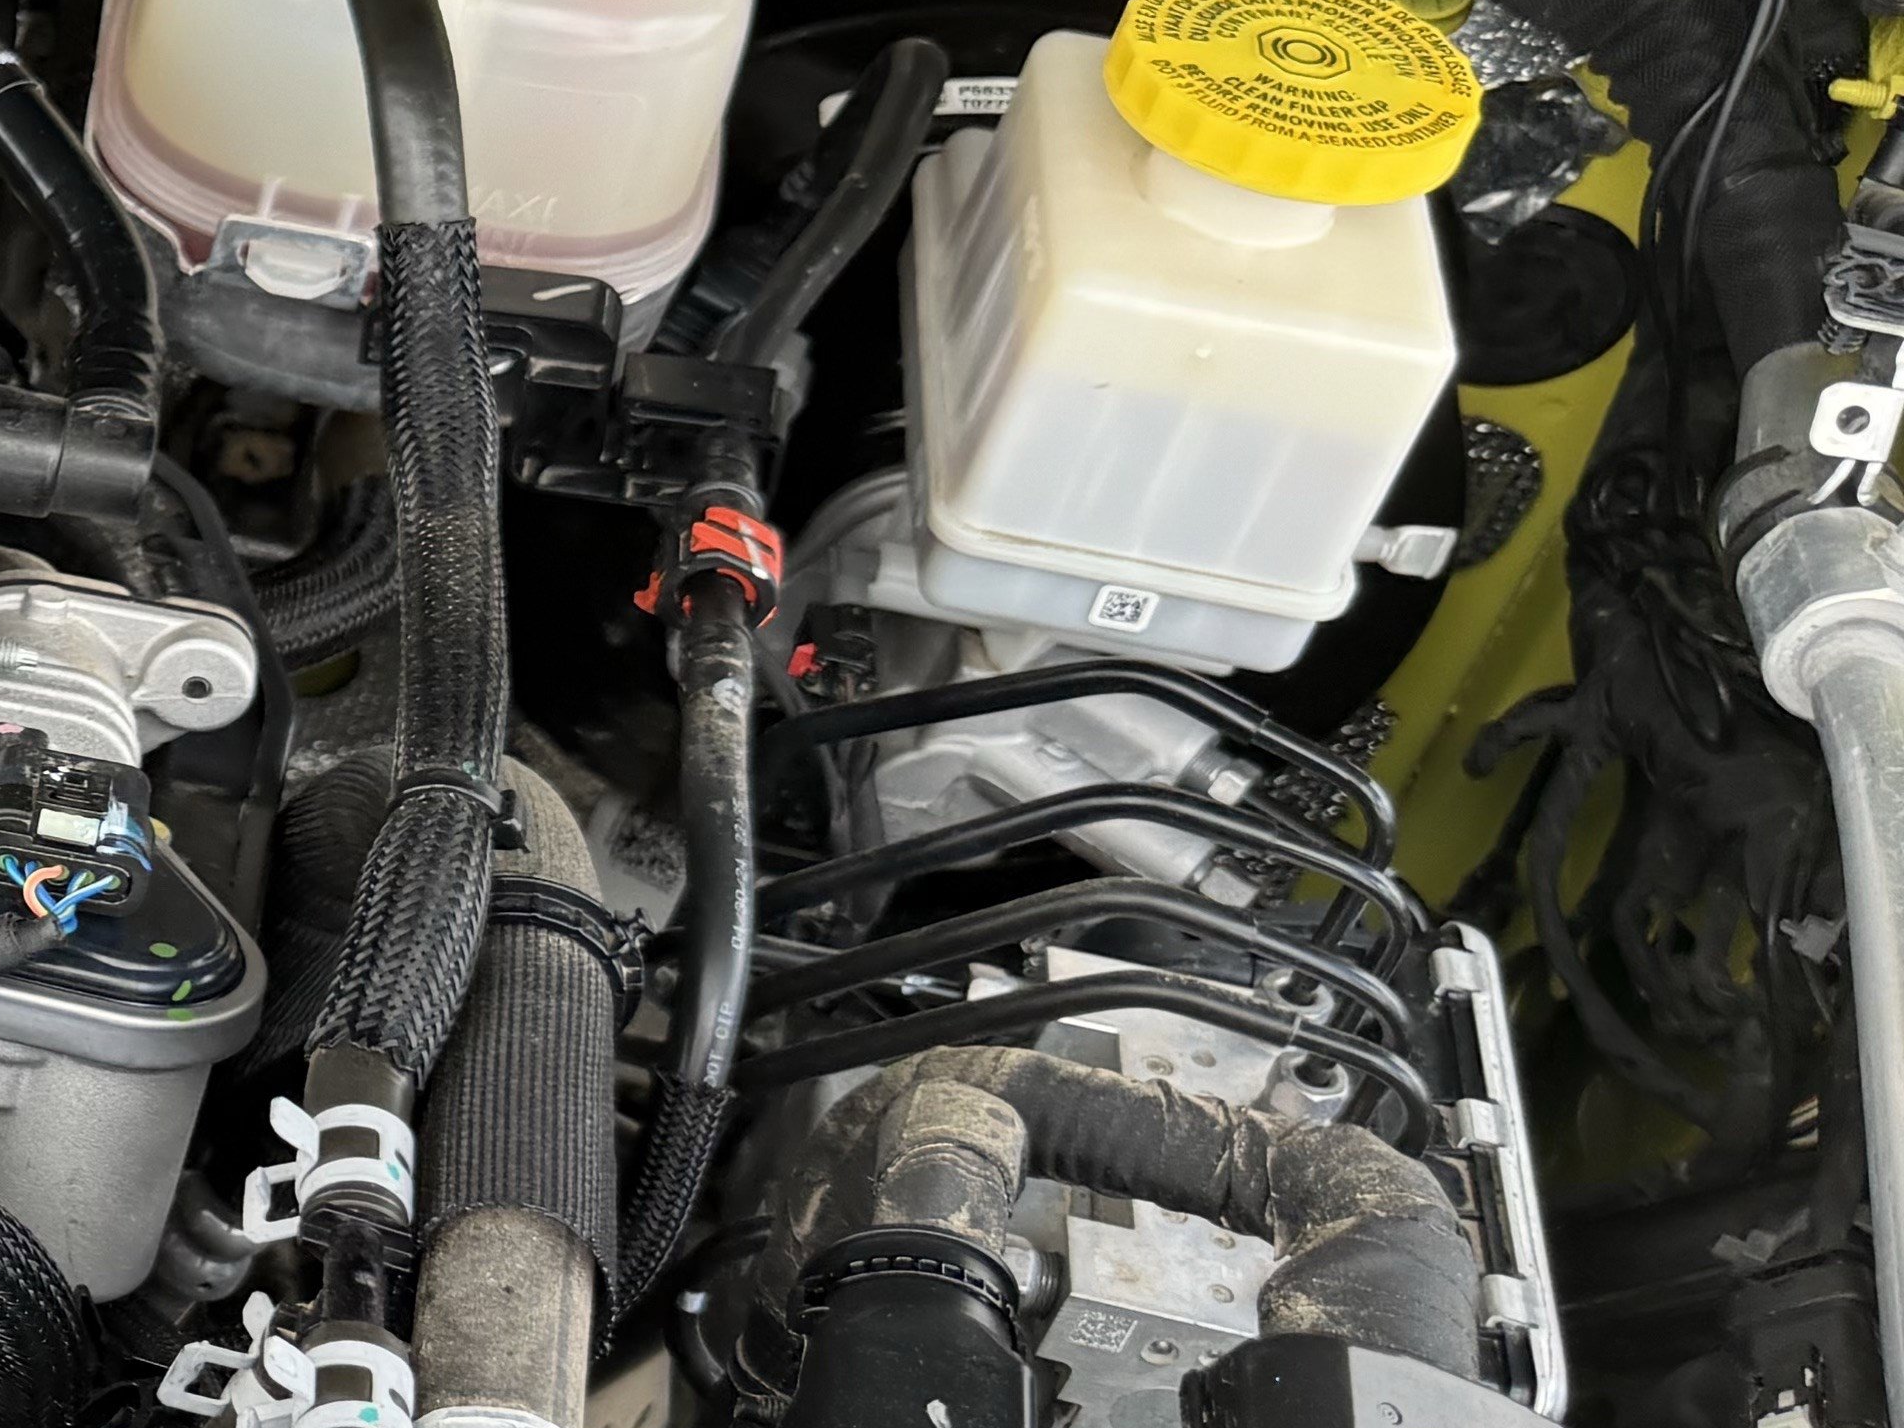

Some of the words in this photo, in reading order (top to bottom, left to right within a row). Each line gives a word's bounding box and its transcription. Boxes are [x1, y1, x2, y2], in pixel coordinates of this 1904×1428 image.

[1372, 14, 1443, 85] UNIQUEMENT
[1389, 9, 1419, 26] DE
[1410, 23, 1471, 98] REMPLISSAGE
[1148, 59, 1188, 81] DOT
[1187, 88, 1239, 116] FLUID
[1238, 113, 1294, 138] FROM
[1294, 128, 1311, 143] A
[1315, 132, 1391, 149] SEALED
[1386, 108, 1464, 147] CONTAINER
[1176, 62, 1246, 107] BEFORE
[1358, 116, 1401, 134] USE
[1394, 101, 1434, 126] ONLY
[1218, 74, 1285, 110] CLEAN
[1287, 99, 1360, 119] FILLER
[1356, 98, 1391, 117] CAP
[1252, 71, 1361, 102] WARNING:
